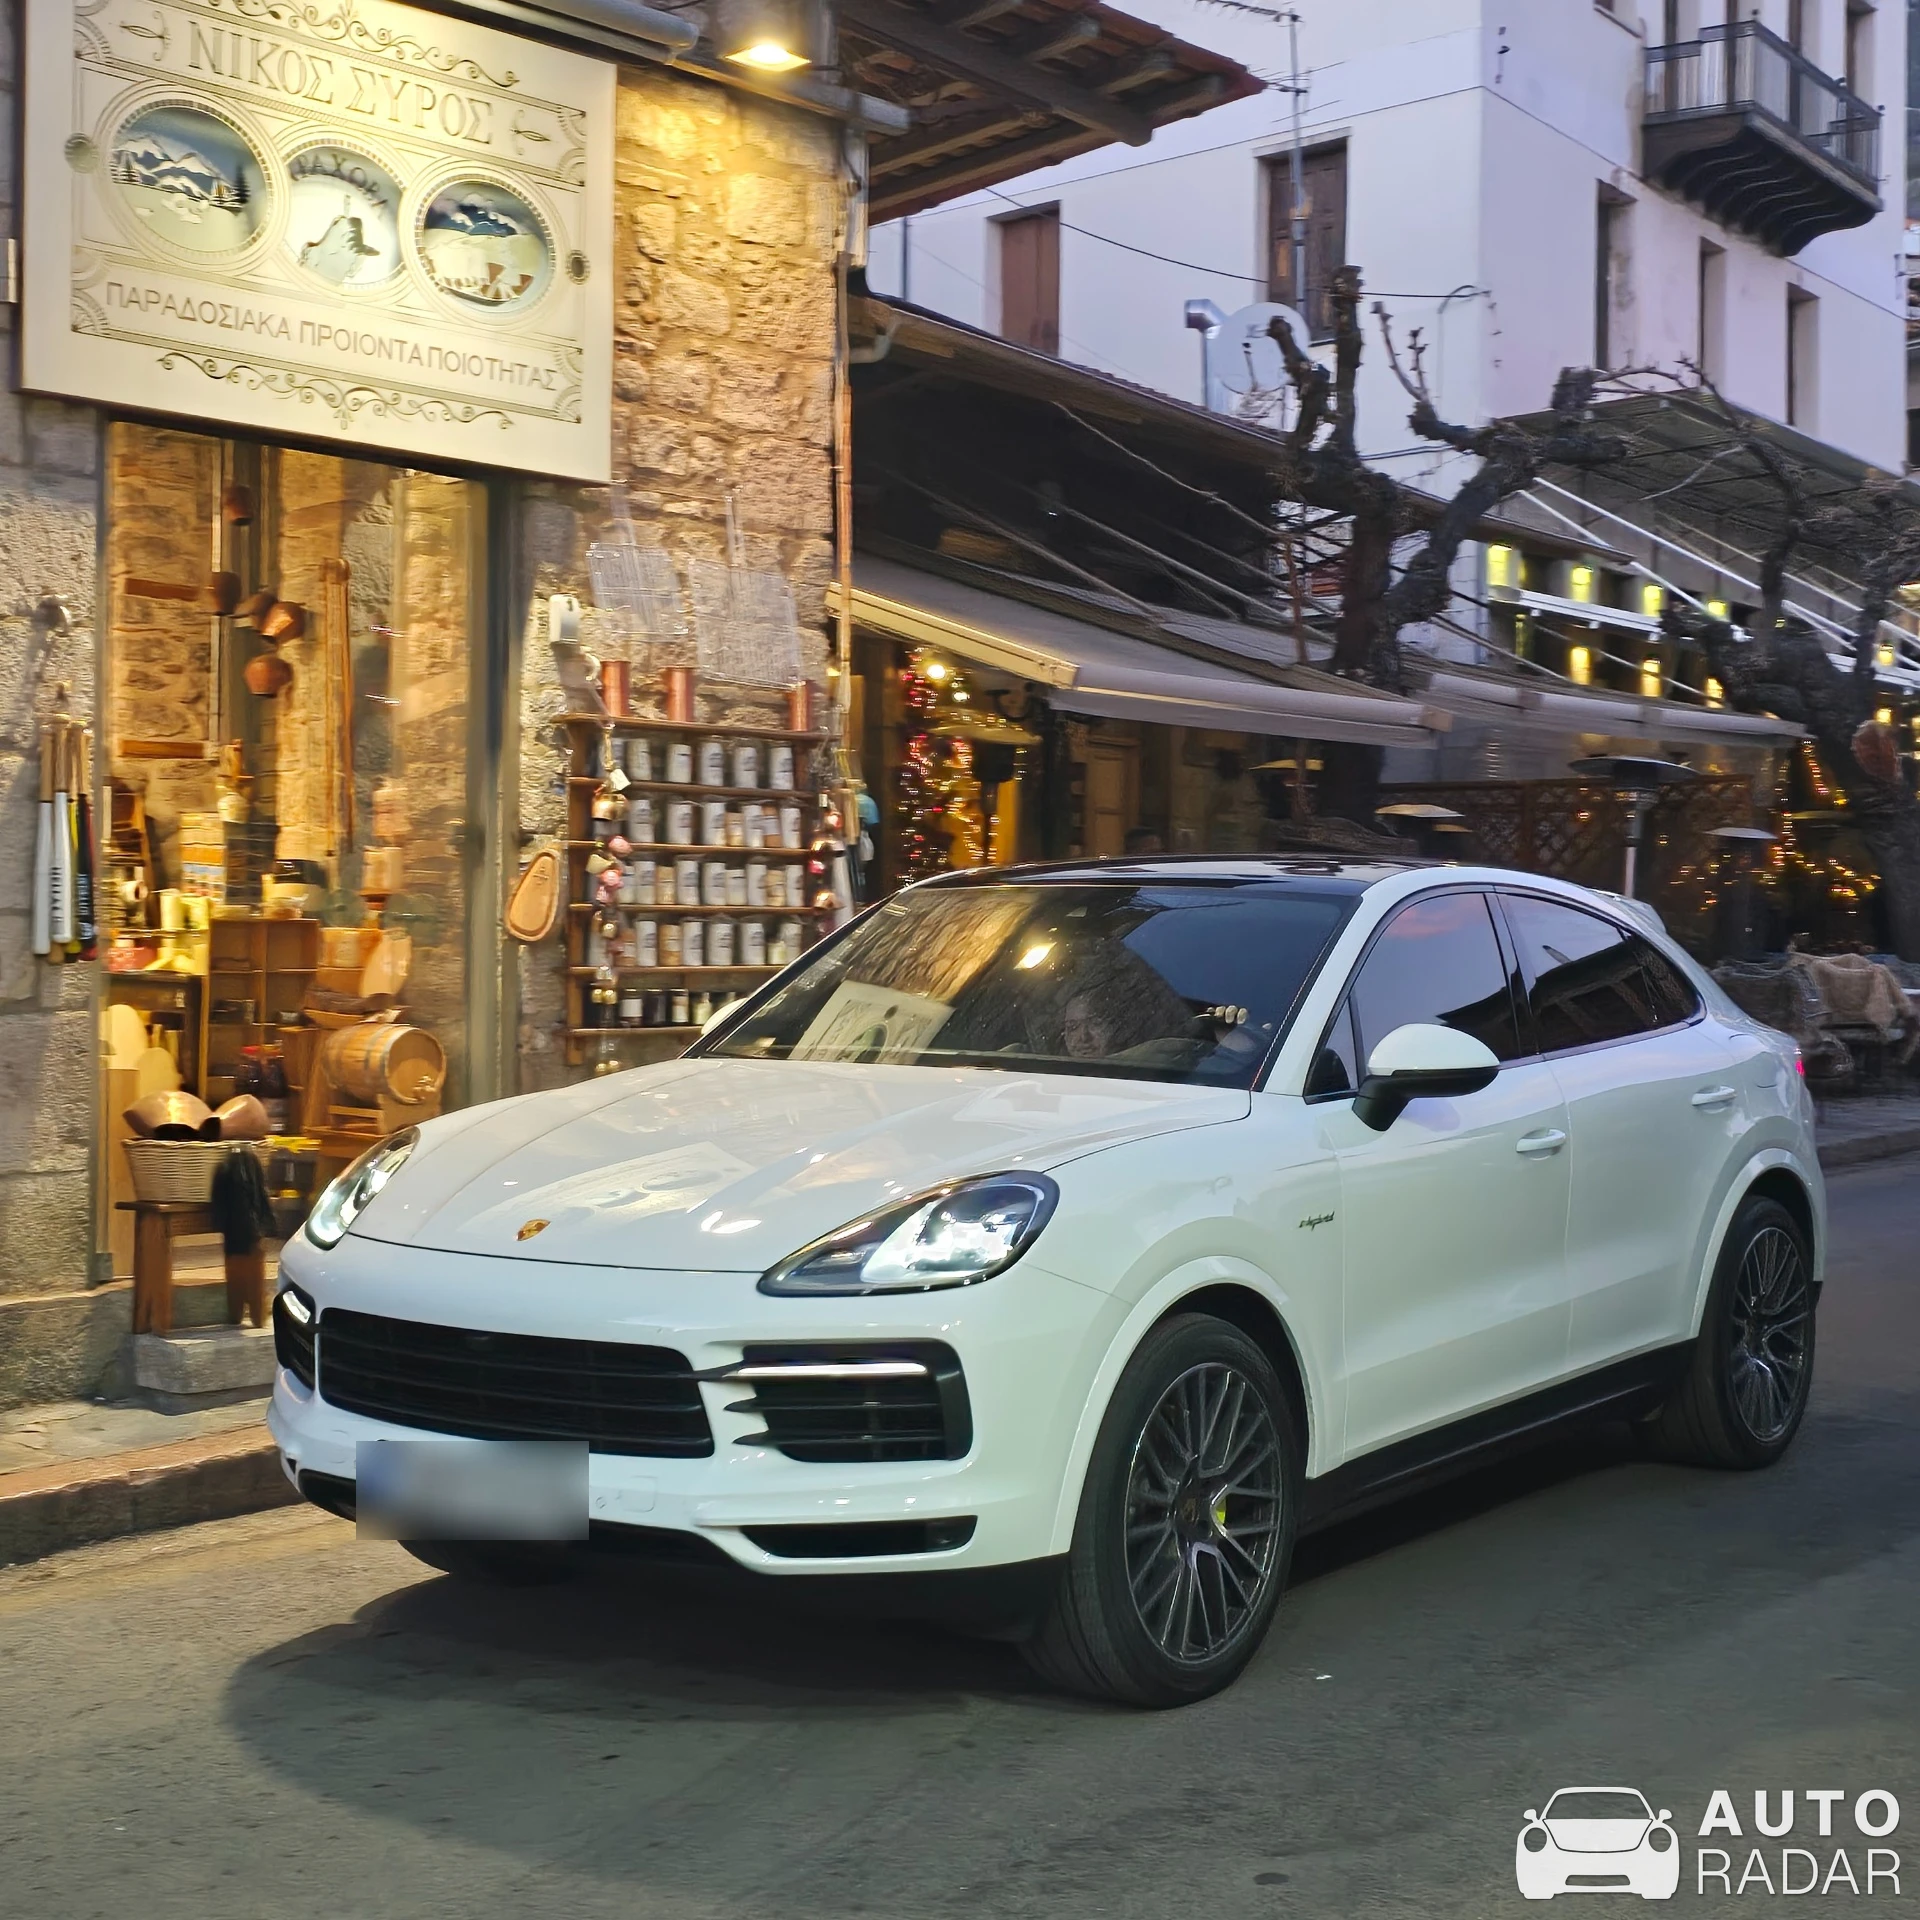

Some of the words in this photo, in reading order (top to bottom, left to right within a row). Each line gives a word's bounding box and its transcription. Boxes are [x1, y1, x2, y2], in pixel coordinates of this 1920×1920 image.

[188, 20, 335, 105] ΝΙΚΟΣ
[346, 65, 495, 145] ΣΥΡΟΣ
[106, 281, 292, 341] ΠΑΡΑΔΟΣΙΑΚΑ
[299, 320, 425, 367] ΠΡΟΙΟΝΤΑ
[428, 346, 558, 391] ΠΟΙΟΤΗΤΑΣ
